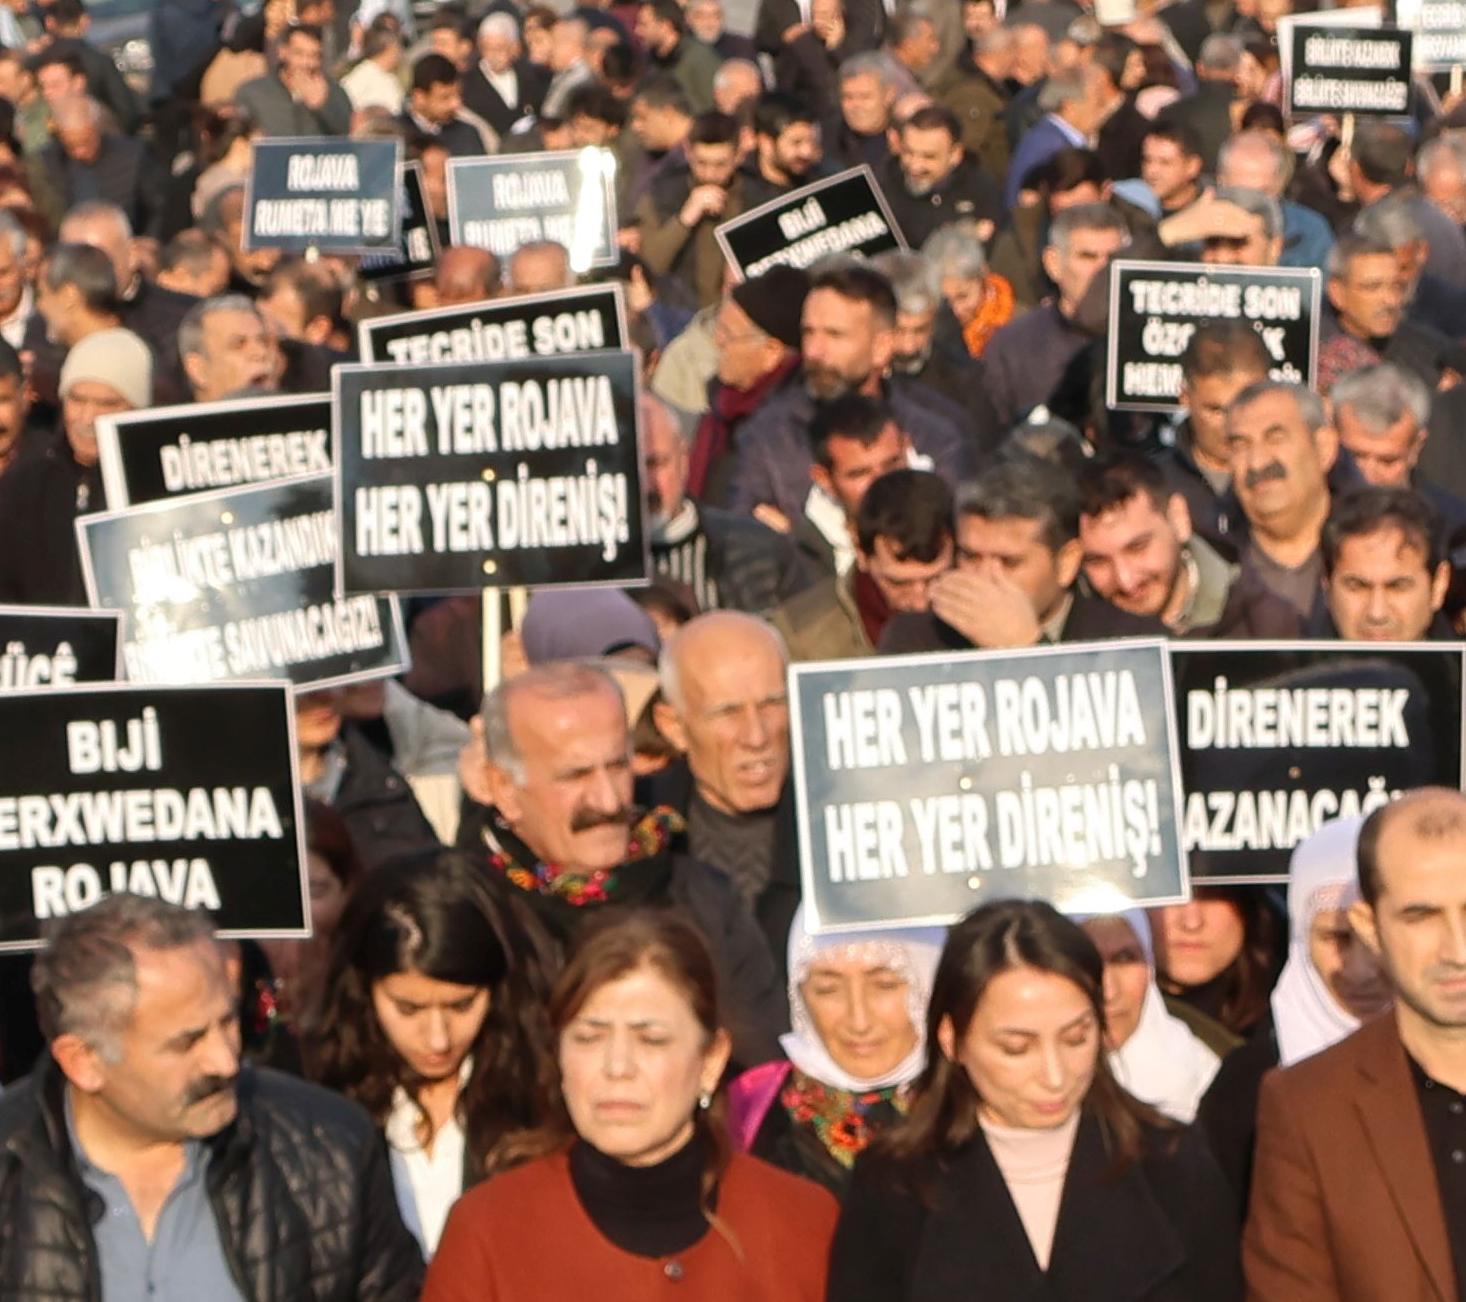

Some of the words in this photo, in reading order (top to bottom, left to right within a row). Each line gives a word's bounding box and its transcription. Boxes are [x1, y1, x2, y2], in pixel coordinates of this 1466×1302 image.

[531, 308, 605, 355] SON
[360, 388, 429, 459] HER
[432, 383, 498, 455] YER
[499, 374, 619, 451] ROJAVA
[354, 485, 423, 558] HER
[426, 480, 494, 555] YER
[497, 456, 629, 563] DİRENİŞ!
[65, 704, 163, 775] BIJİ
[823, 686, 906, 771] HER
[909, 679, 990, 764] YER
[993, 669, 1146, 757] ROJAVA
[1187, 676, 1411, 749] DİRENEREK
[824, 799, 908, 884] HER
[913, 793, 995, 876] YER
[998, 766, 1162, 879] DİRENİŞ!
